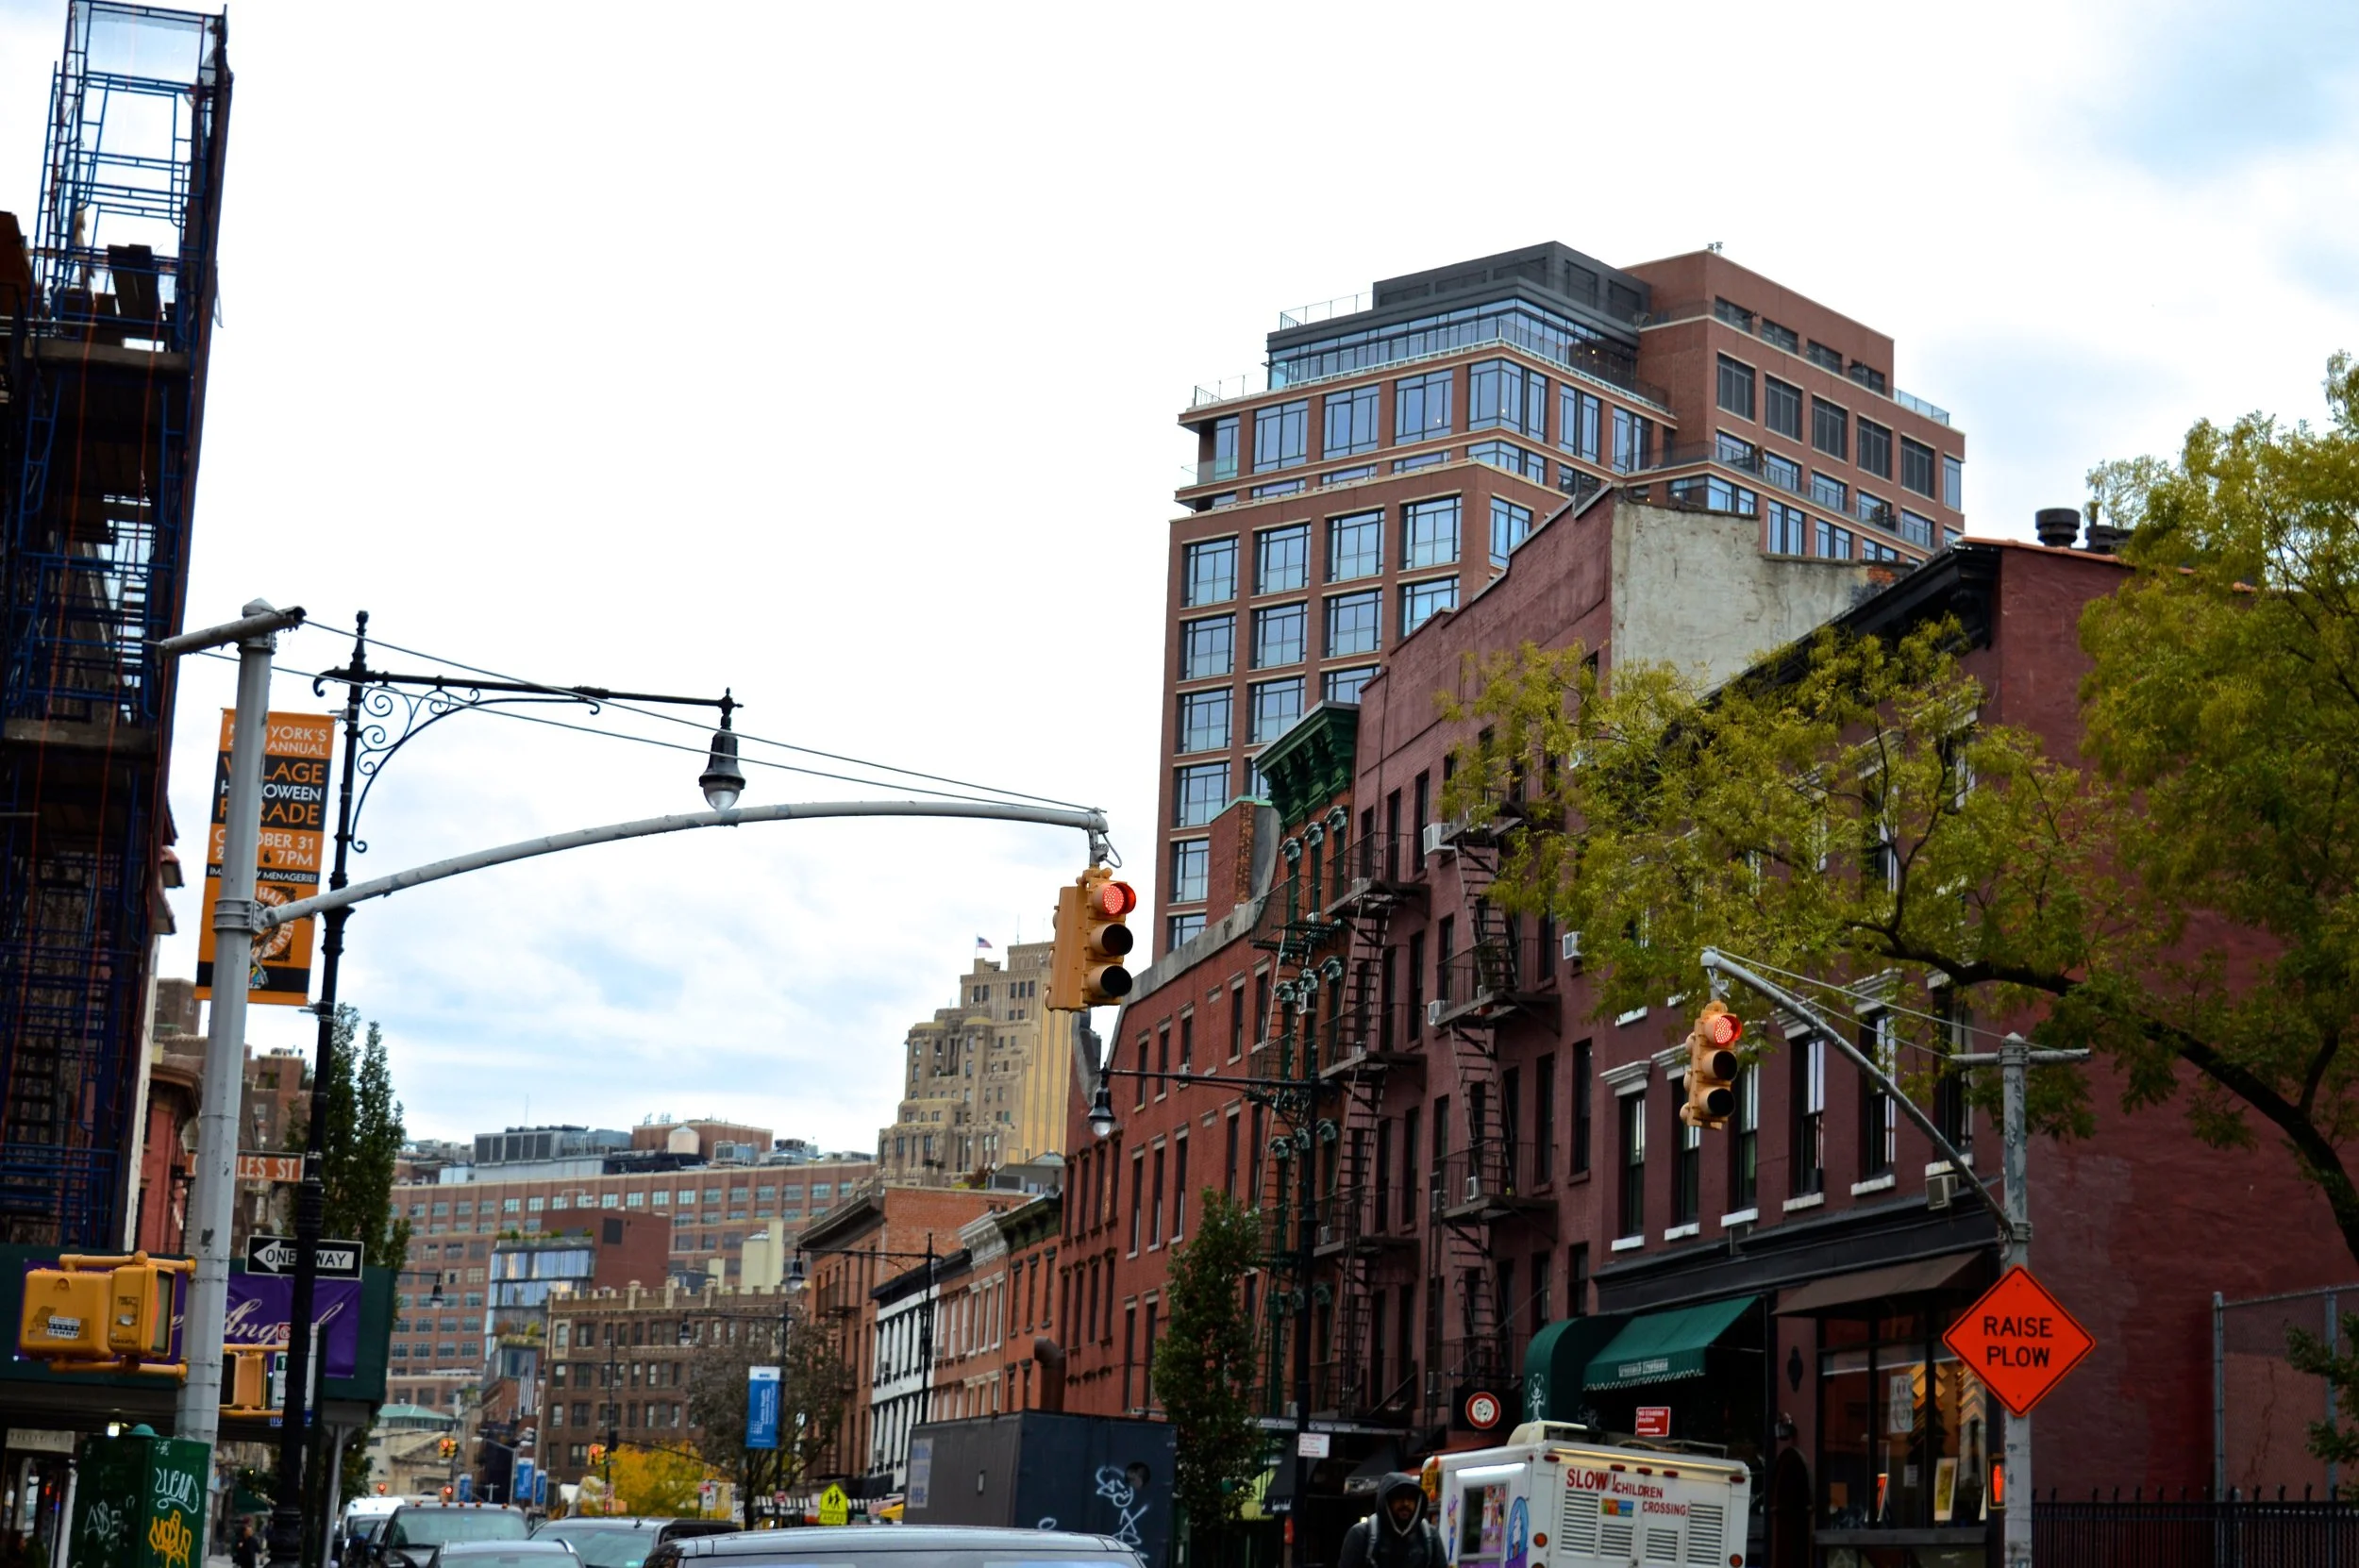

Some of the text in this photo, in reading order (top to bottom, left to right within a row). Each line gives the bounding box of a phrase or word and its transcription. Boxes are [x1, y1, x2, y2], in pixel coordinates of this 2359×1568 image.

[271, 726, 327, 742] YORK'S
[267, 741, 326, 756] ANNUAL
[297, 836, 315, 850] 31
[276, 1159, 296, 1179] ST
[265, 1248, 347, 1267] ONE WAY
[1983, 1315, 2053, 1338] RAISE
[1986, 1345, 2049, 1368] PLOW
[1614, 1481, 1664, 1499] CHILDREN
